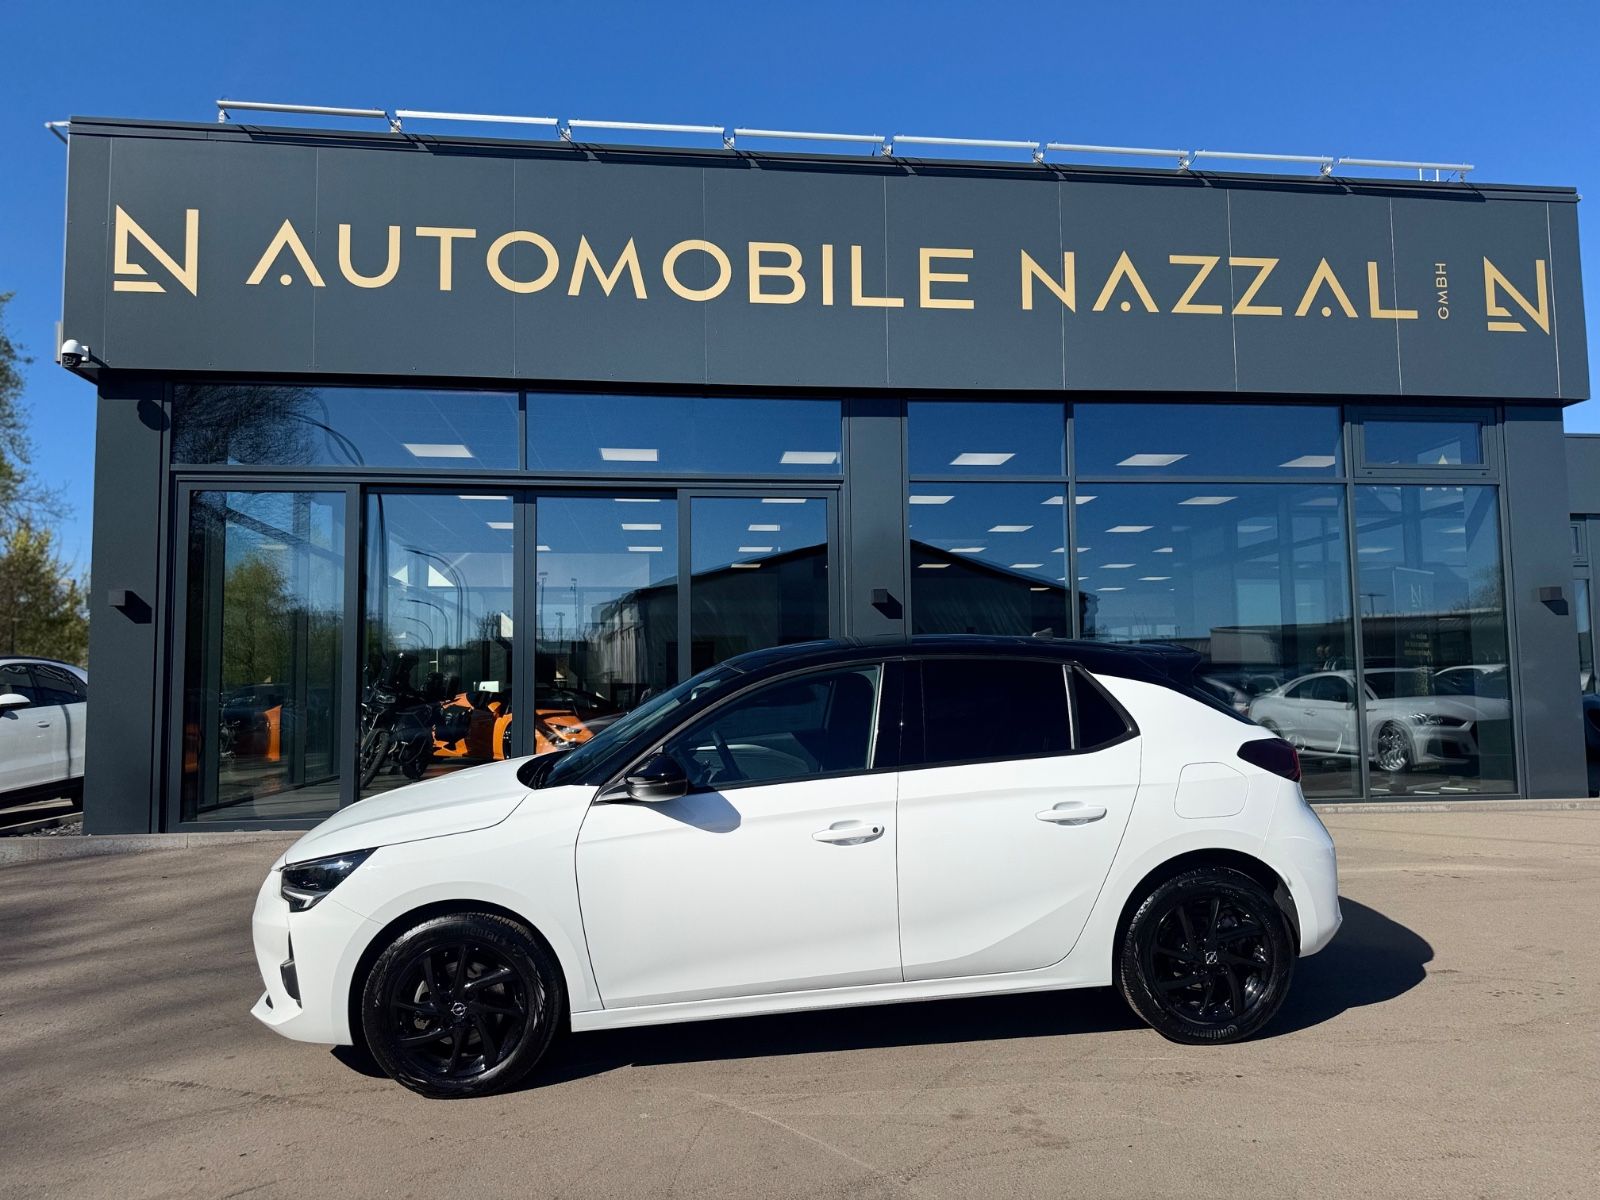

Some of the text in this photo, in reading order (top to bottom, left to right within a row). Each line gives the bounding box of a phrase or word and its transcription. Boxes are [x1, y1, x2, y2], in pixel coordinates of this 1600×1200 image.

[248, 223, 1418, 320] AUTOMOBILE NAZZAL
[1434, 263, 1449, 320] GMBH
